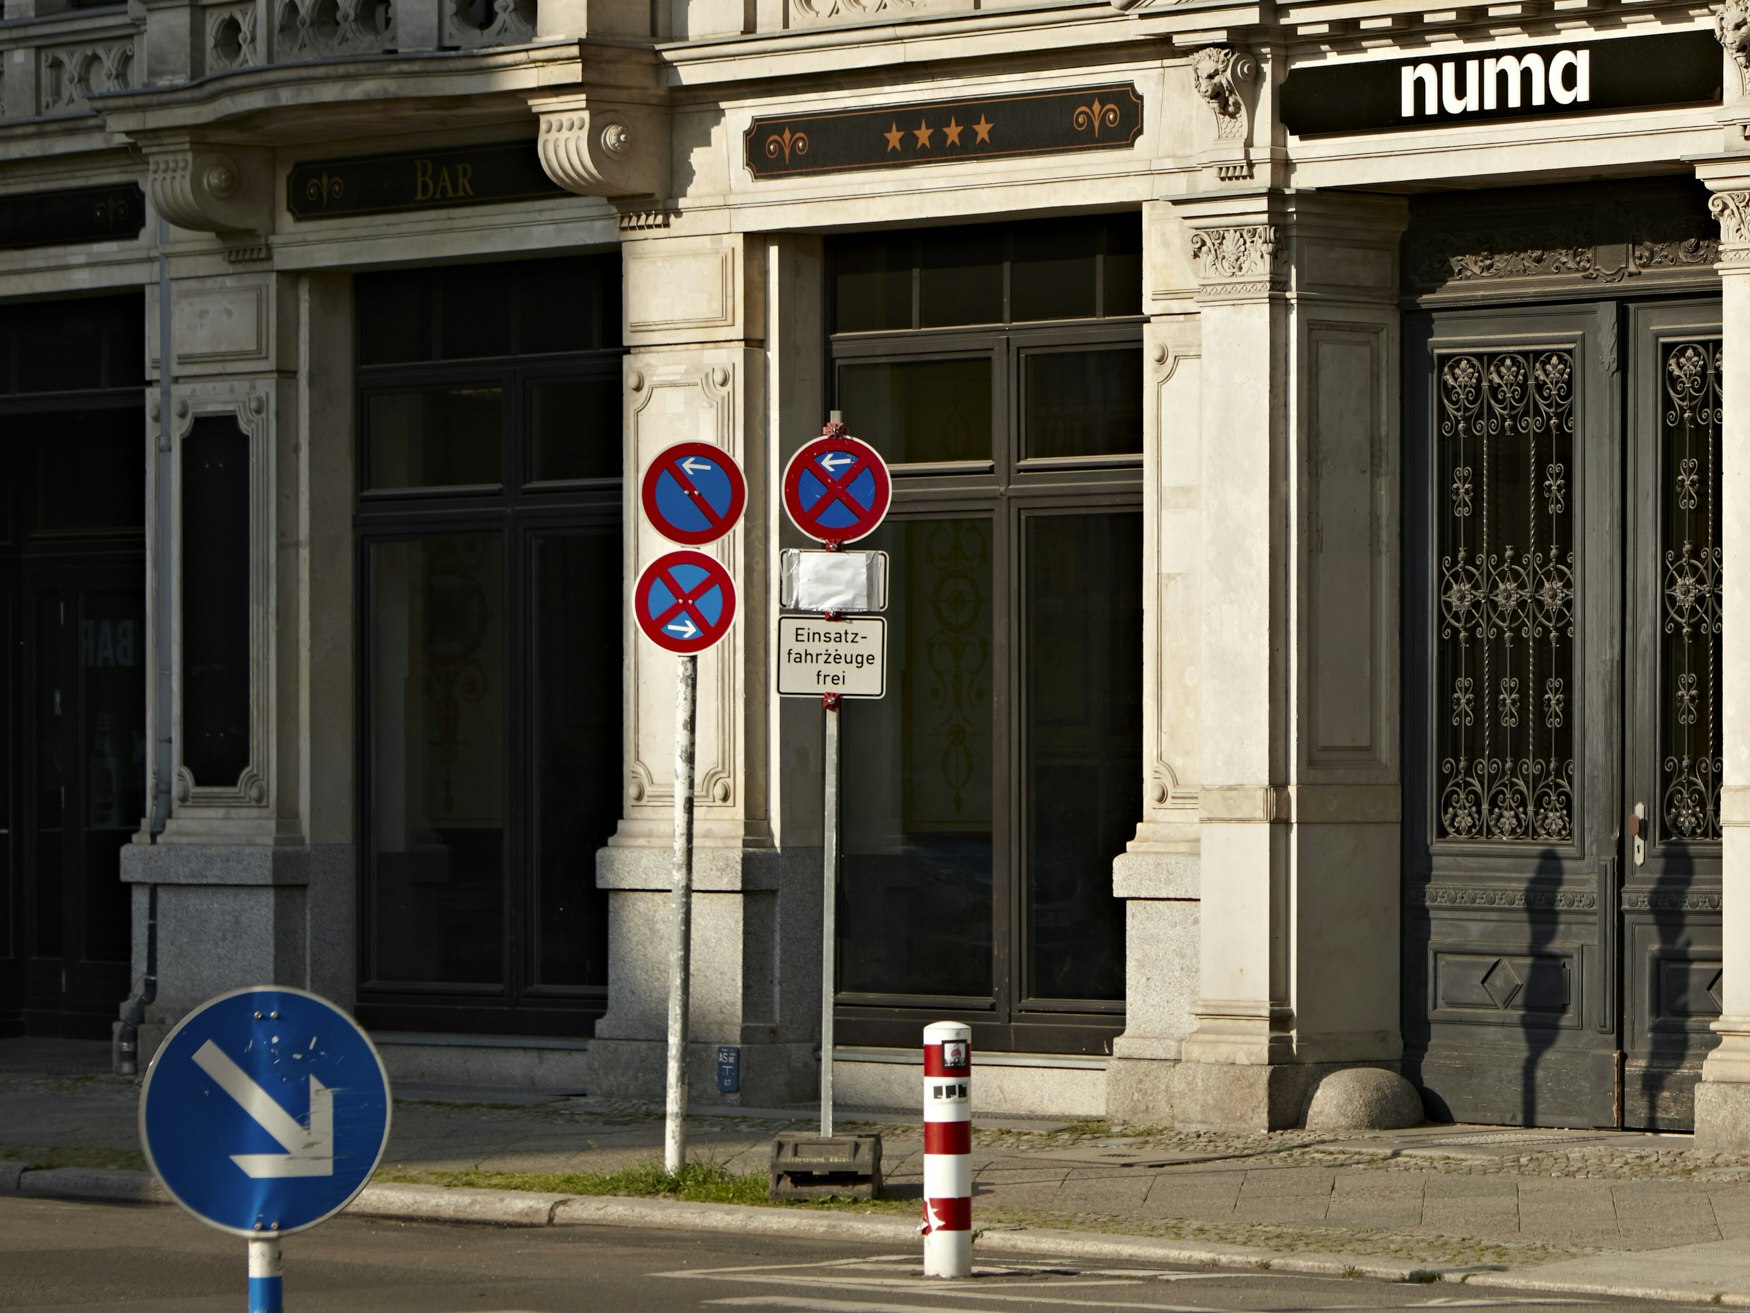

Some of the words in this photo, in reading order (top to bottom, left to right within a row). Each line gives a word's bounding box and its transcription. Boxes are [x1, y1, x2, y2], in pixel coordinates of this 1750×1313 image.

[1401, 49, 1590, 118] numa
[795, 627, 868, 644] Einsatz-
[787, 649, 876, 669] fahrzeuge
[816, 670, 846, 686] frei
